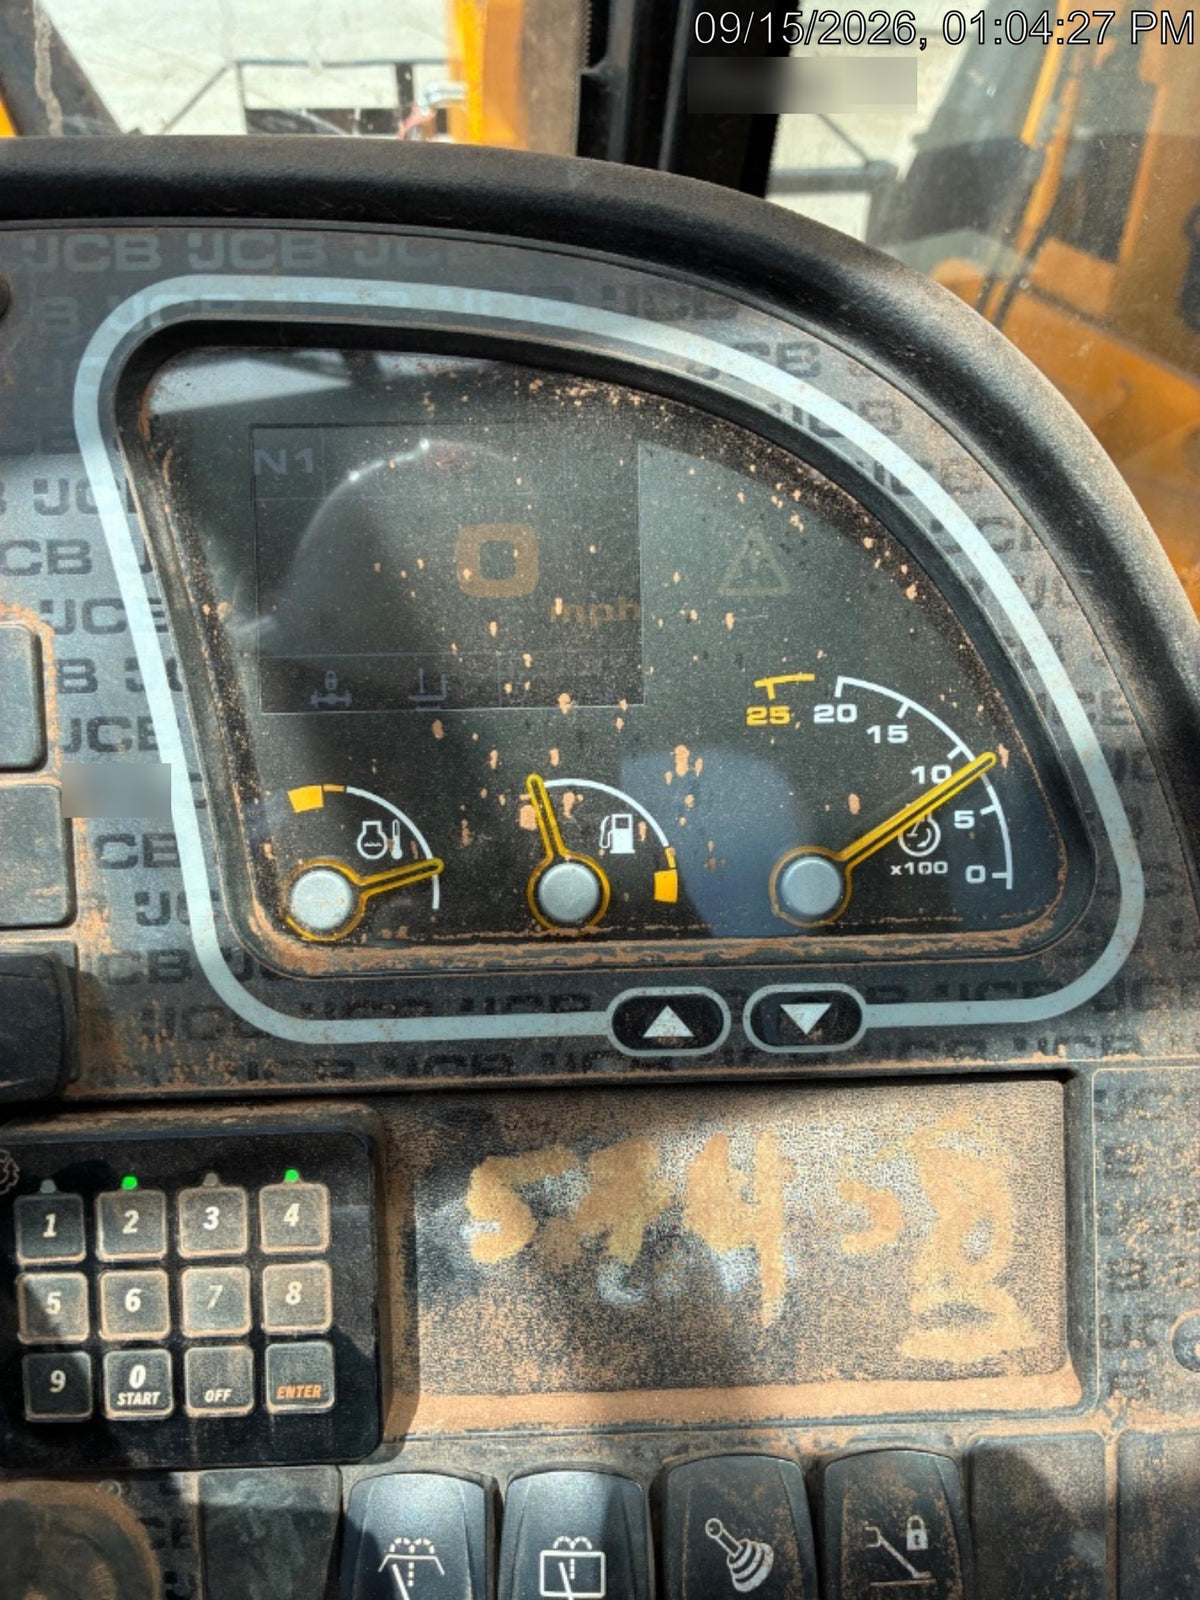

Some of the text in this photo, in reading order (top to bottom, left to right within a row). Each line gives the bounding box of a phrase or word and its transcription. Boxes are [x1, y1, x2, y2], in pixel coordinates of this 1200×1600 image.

[22, 233, 162, 272] JCB
[187, 231, 328, 270] JCB
[253, 448, 315, 475] N1
[455, 522, 540, 598] 0
[550, 597, 640, 626] mph
[746, 706, 791, 726] 25
[813, 704, 858, 724] 20
[866, 724, 909, 744] 15
[911, 765, 952, 785] 10
[954, 810, 976, 829] 5
[890, 861, 949, 876] x100
[965, 865, 987, 884] 0
[44, 1214, 57, 1238] 1
[122, 1210, 139, 1235] 2
[203, 1206, 220, 1230] 3
[283, 1203, 300, 1227] 4
[46, 1291, 62, 1315] 5
[125, 1288, 142, 1312] 6
[206, 1285, 223, 1310] 7
[285, 1281, 302, 1305] 8
[51, 1370, 66, 1392] 9
[129, 1364, 147, 1389] 0
[117, 1391, 161, 1406] START
[204, 1388, 232, 1403] OFF
[276, 1384, 322, 1399] ENTER
